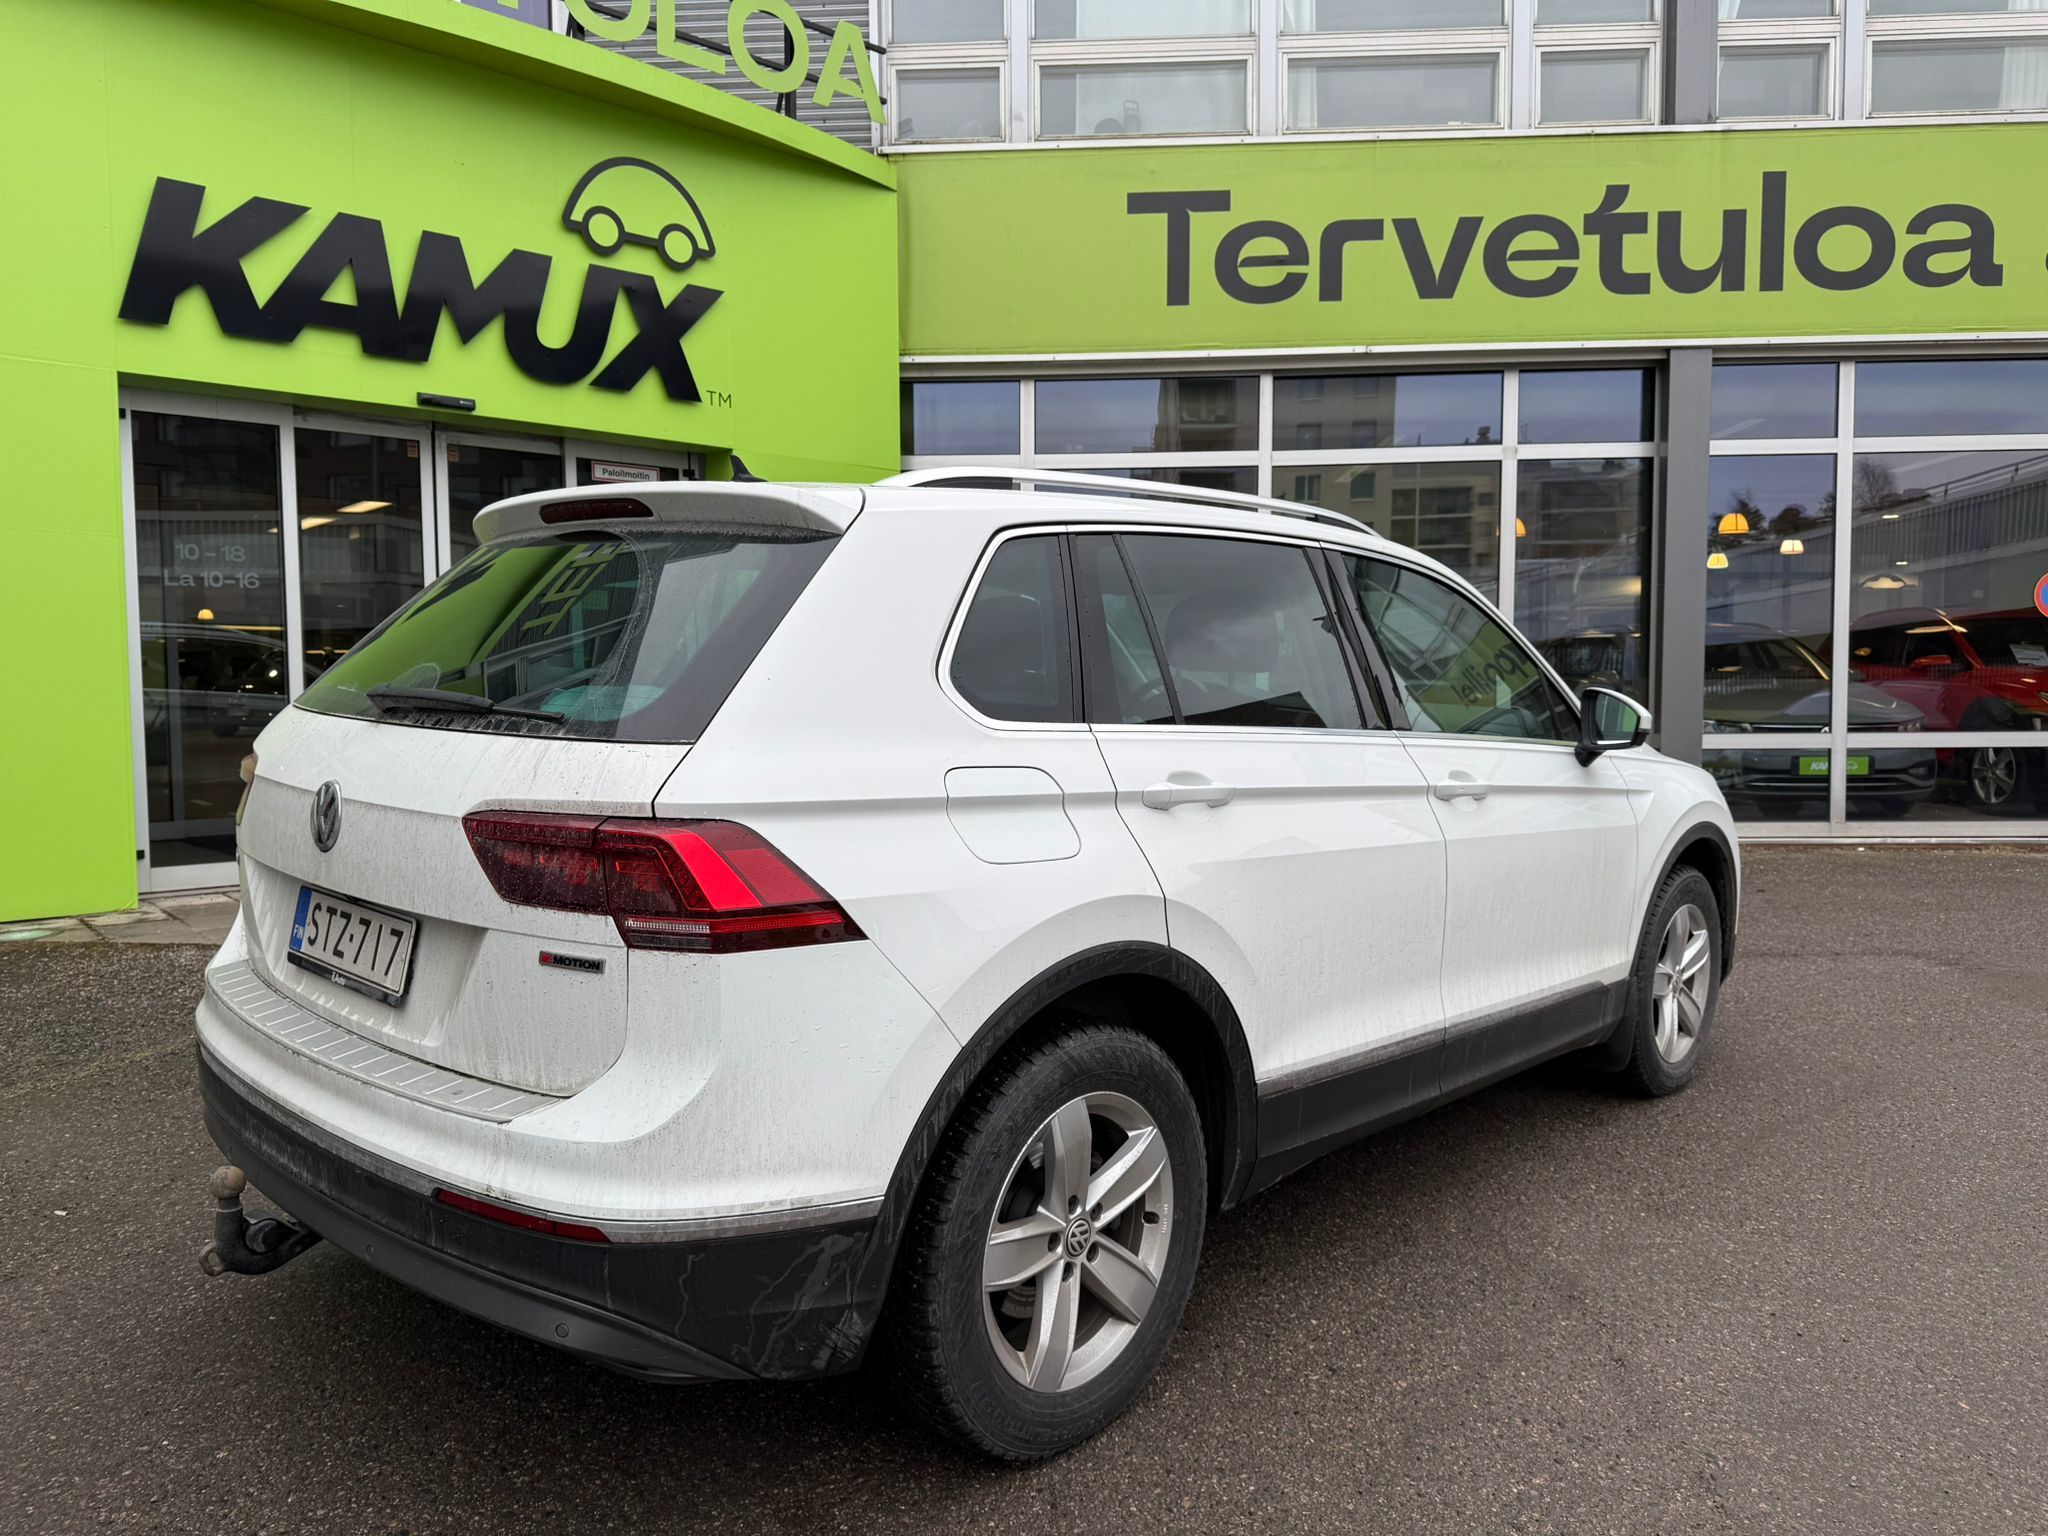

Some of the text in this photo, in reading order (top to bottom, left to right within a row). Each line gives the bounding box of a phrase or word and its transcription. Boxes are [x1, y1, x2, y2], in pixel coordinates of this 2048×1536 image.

[497, 0, 887, 126] LOA
[1127, 170, 2004, 307] Tervetuloa
[118, 176, 732, 408] KAMUX TM
[602, 467, 650, 480] Paloilmoitin
[163, 568, 196, 587] La
[175, 543, 199, 561] 10
[221, 545, 246, 562] 18
[307, 901, 404, 977] STZ-717
